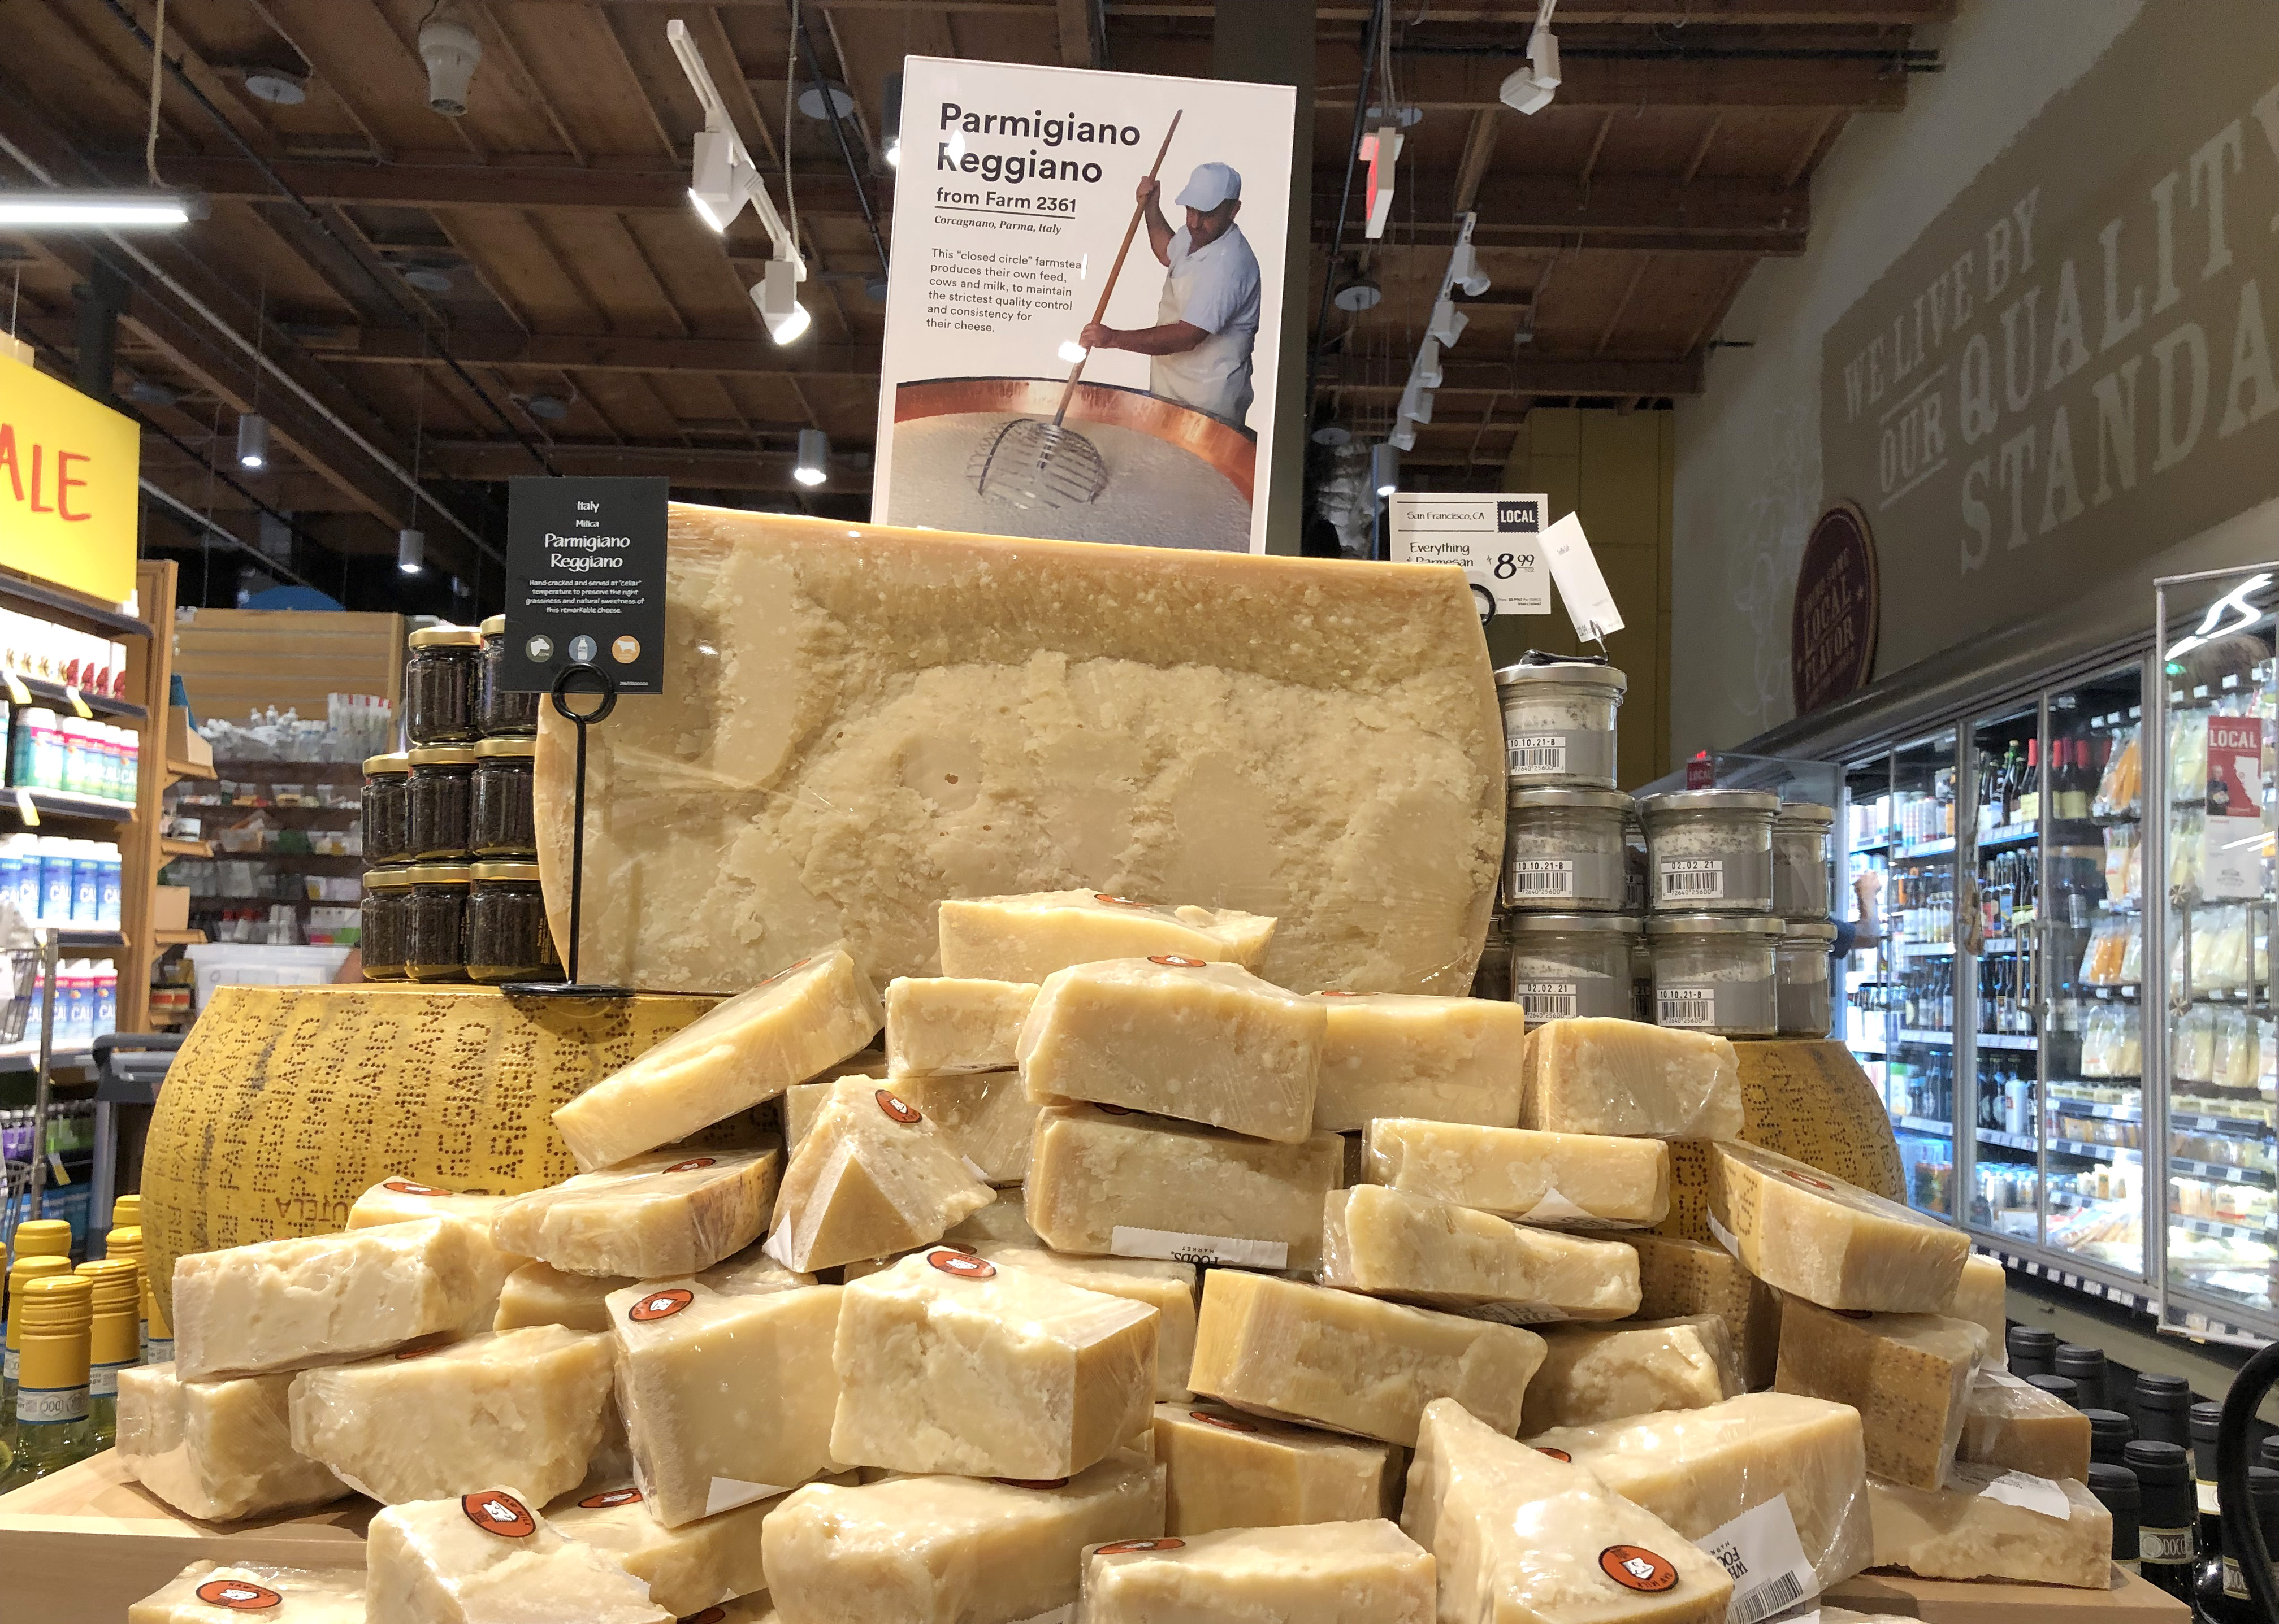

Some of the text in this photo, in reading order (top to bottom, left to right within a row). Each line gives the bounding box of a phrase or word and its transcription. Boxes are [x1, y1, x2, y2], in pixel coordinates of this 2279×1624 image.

[940, 102, 1140, 147] Parmigiano
[936, 188, 1076, 213] from Farm 2361
[934, 215, 1061, 235] Corcagnano, Parma, Italy
[932, 248, 1088, 270] This “closed circle” farmstea
[930, 264, 982, 275] produces
[985, 267, 1010, 277] their
[1040, 271, 1067, 283] feed,
[930, 277, 1072, 296] cows and milk, to maintain
[1879, 80, 2279, 494] OUR QUALIT
[929, 290, 1072, 310] the strictest quality control
[1843, 185, 2043, 424] WE LIVE BY
[928, 305, 1032, 321] and consistency for
[926, 318, 995, 332] their cheese.
[1960, 278, 2279, 575] STANDA
[0, 423, 91, 521] ALE
[577, 501, 599, 513] Italy
[1407, 511, 1425, 520] San
[1427, 511, 1471, 521] Francisco,
[1501, 510, 1535, 523] LOCAL
[545, 533, 630, 552] Parmigiano
[1410, 542, 1470, 555] Everything
[551, 553, 623, 572] Reggiano
[1511, 739, 1555, 747] 10.10.21-B
[2209, 730, 2257, 748] LOCAL
[1672, 861, 1713, 870] 02.02.21
[1528, 984, 1567, 993] 02.02.21
[332, 1021, 398, 1198] REGGIANO
[436, 1023, 492, 1178] EGGIANO
[276, 1197, 349, 1222] UTELA
[1710, 1541, 1730, 1555] MARK
